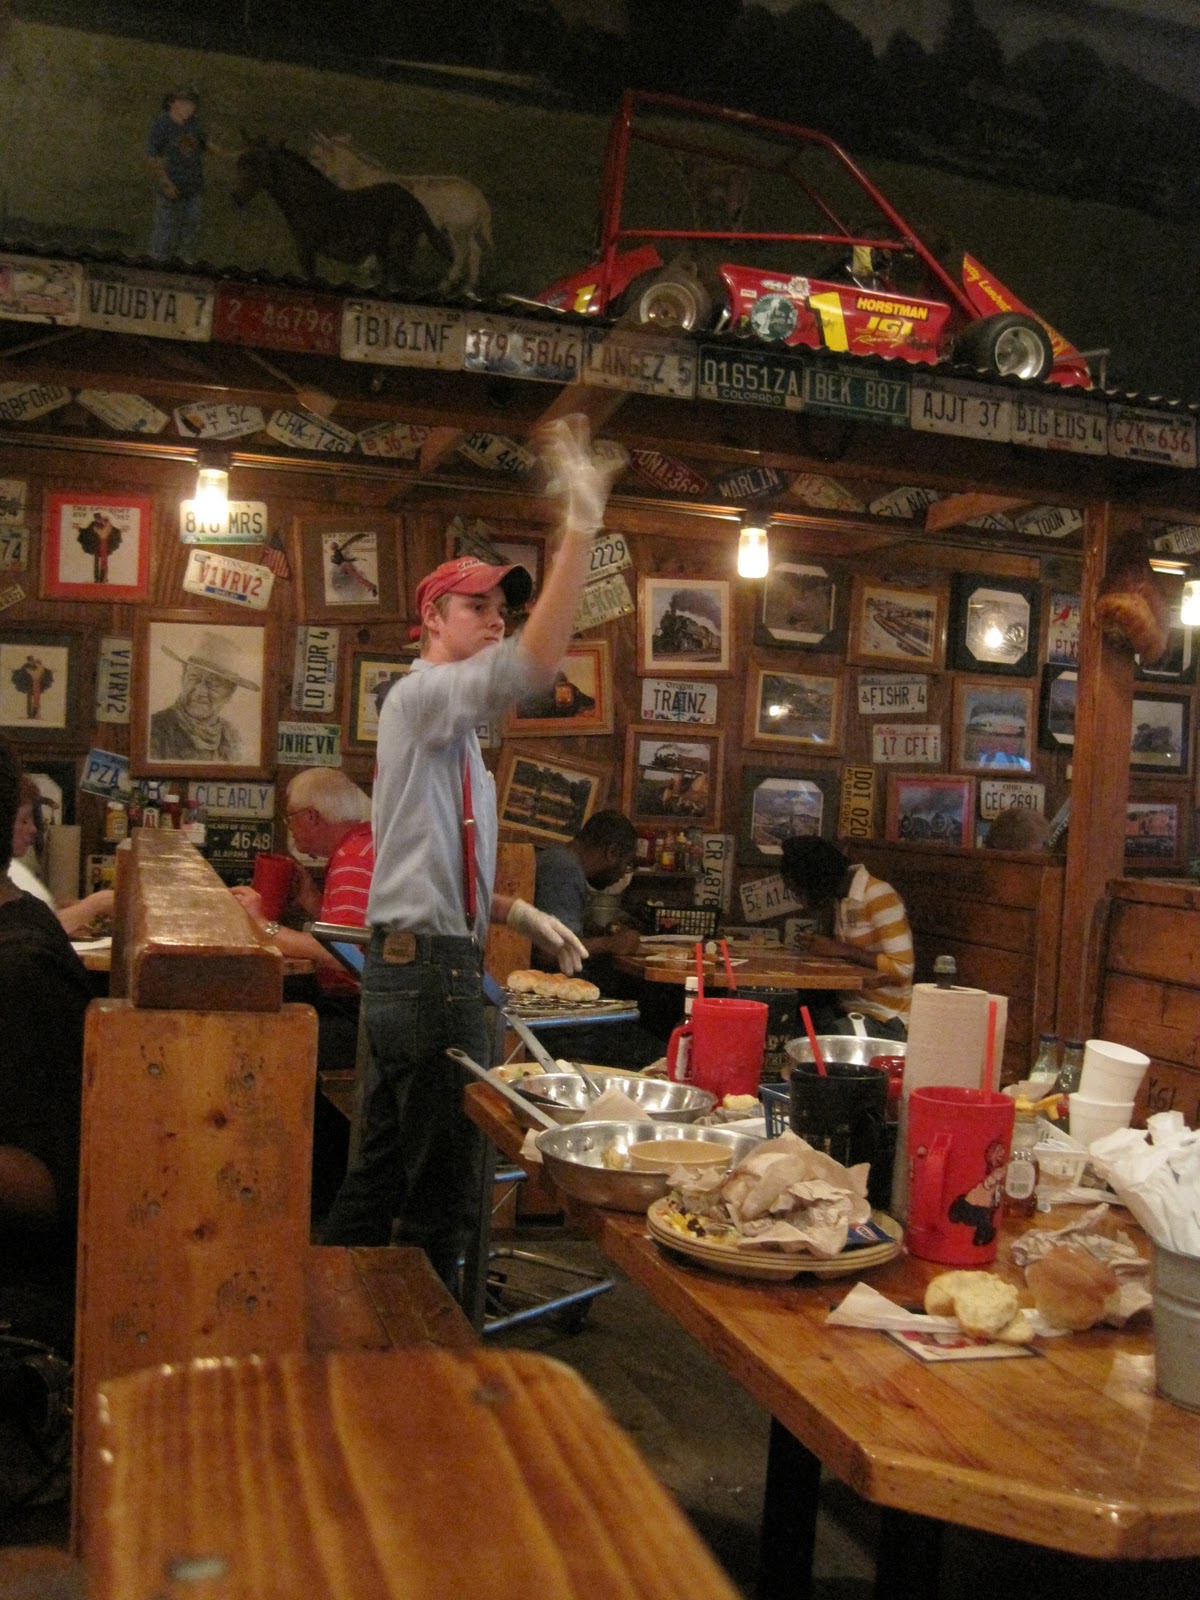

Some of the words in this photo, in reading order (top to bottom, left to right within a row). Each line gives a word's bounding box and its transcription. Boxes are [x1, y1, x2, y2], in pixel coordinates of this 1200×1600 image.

[89, 283, 177, 324] VDUBYA
[856, 296, 929, 321] HORSTMAN
[353, 315, 454, 353] 1B16INF
[465, 329, 508, 361] 379
[522, 336, 577, 370] 5846
[722, 389, 782, 404] COLORADO
[979, 402, 1000, 429] 37
[1017, 407, 1048, 435] BIG
[1158, 427, 1190, 453] 636
[718, 467, 779, 499] MARLIN
[227, 511, 263, 535] MRS
[666, 681, 694, 691] Oregon
[870, 686, 910, 706] FISHR
[917, 686, 926, 705] 4
[653, 688, 707, 714] TRAINZ
[881, 736, 898, 756] 17
[195, 785, 269, 810] CLEARLY
[1002, 783, 1023, 791] OHIO
[849, 807, 870, 837] 020
[706, 840, 724, 860] CR
